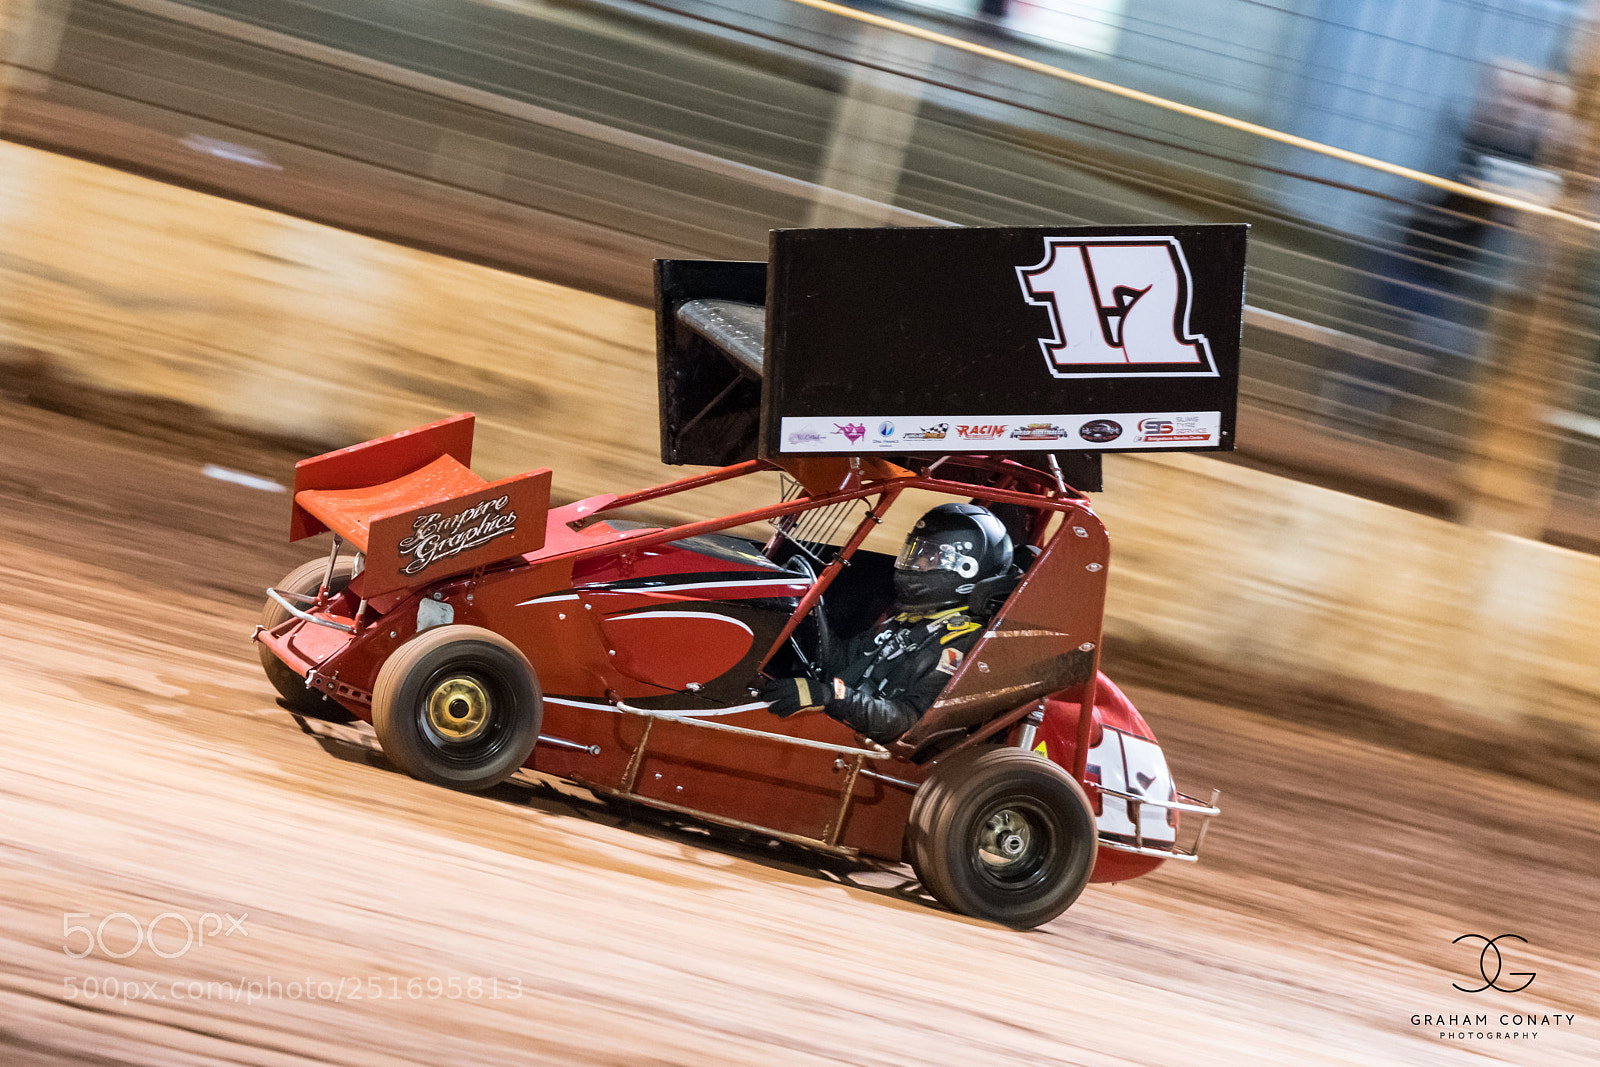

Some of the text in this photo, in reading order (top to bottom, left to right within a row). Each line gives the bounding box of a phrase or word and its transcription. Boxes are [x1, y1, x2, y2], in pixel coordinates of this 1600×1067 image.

[1018, 238, 1216, 376] 17
[400, 495, 509, 554] Empire
[401, 511, 517, 574] Graphics
